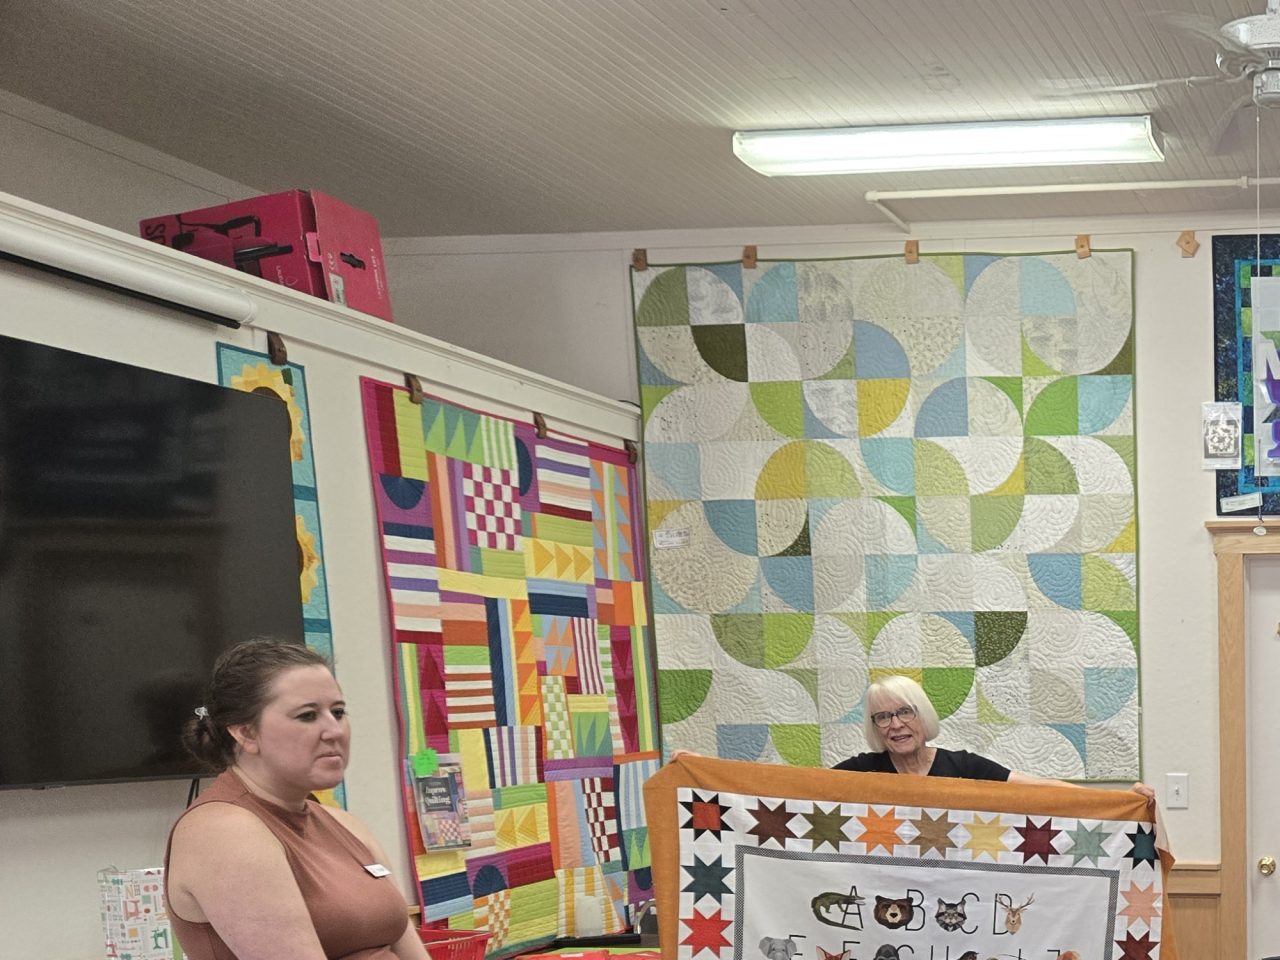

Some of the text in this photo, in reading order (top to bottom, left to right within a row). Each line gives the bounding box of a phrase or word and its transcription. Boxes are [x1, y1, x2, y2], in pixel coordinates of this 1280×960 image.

[842, 885, 1012, 935] A B C D
